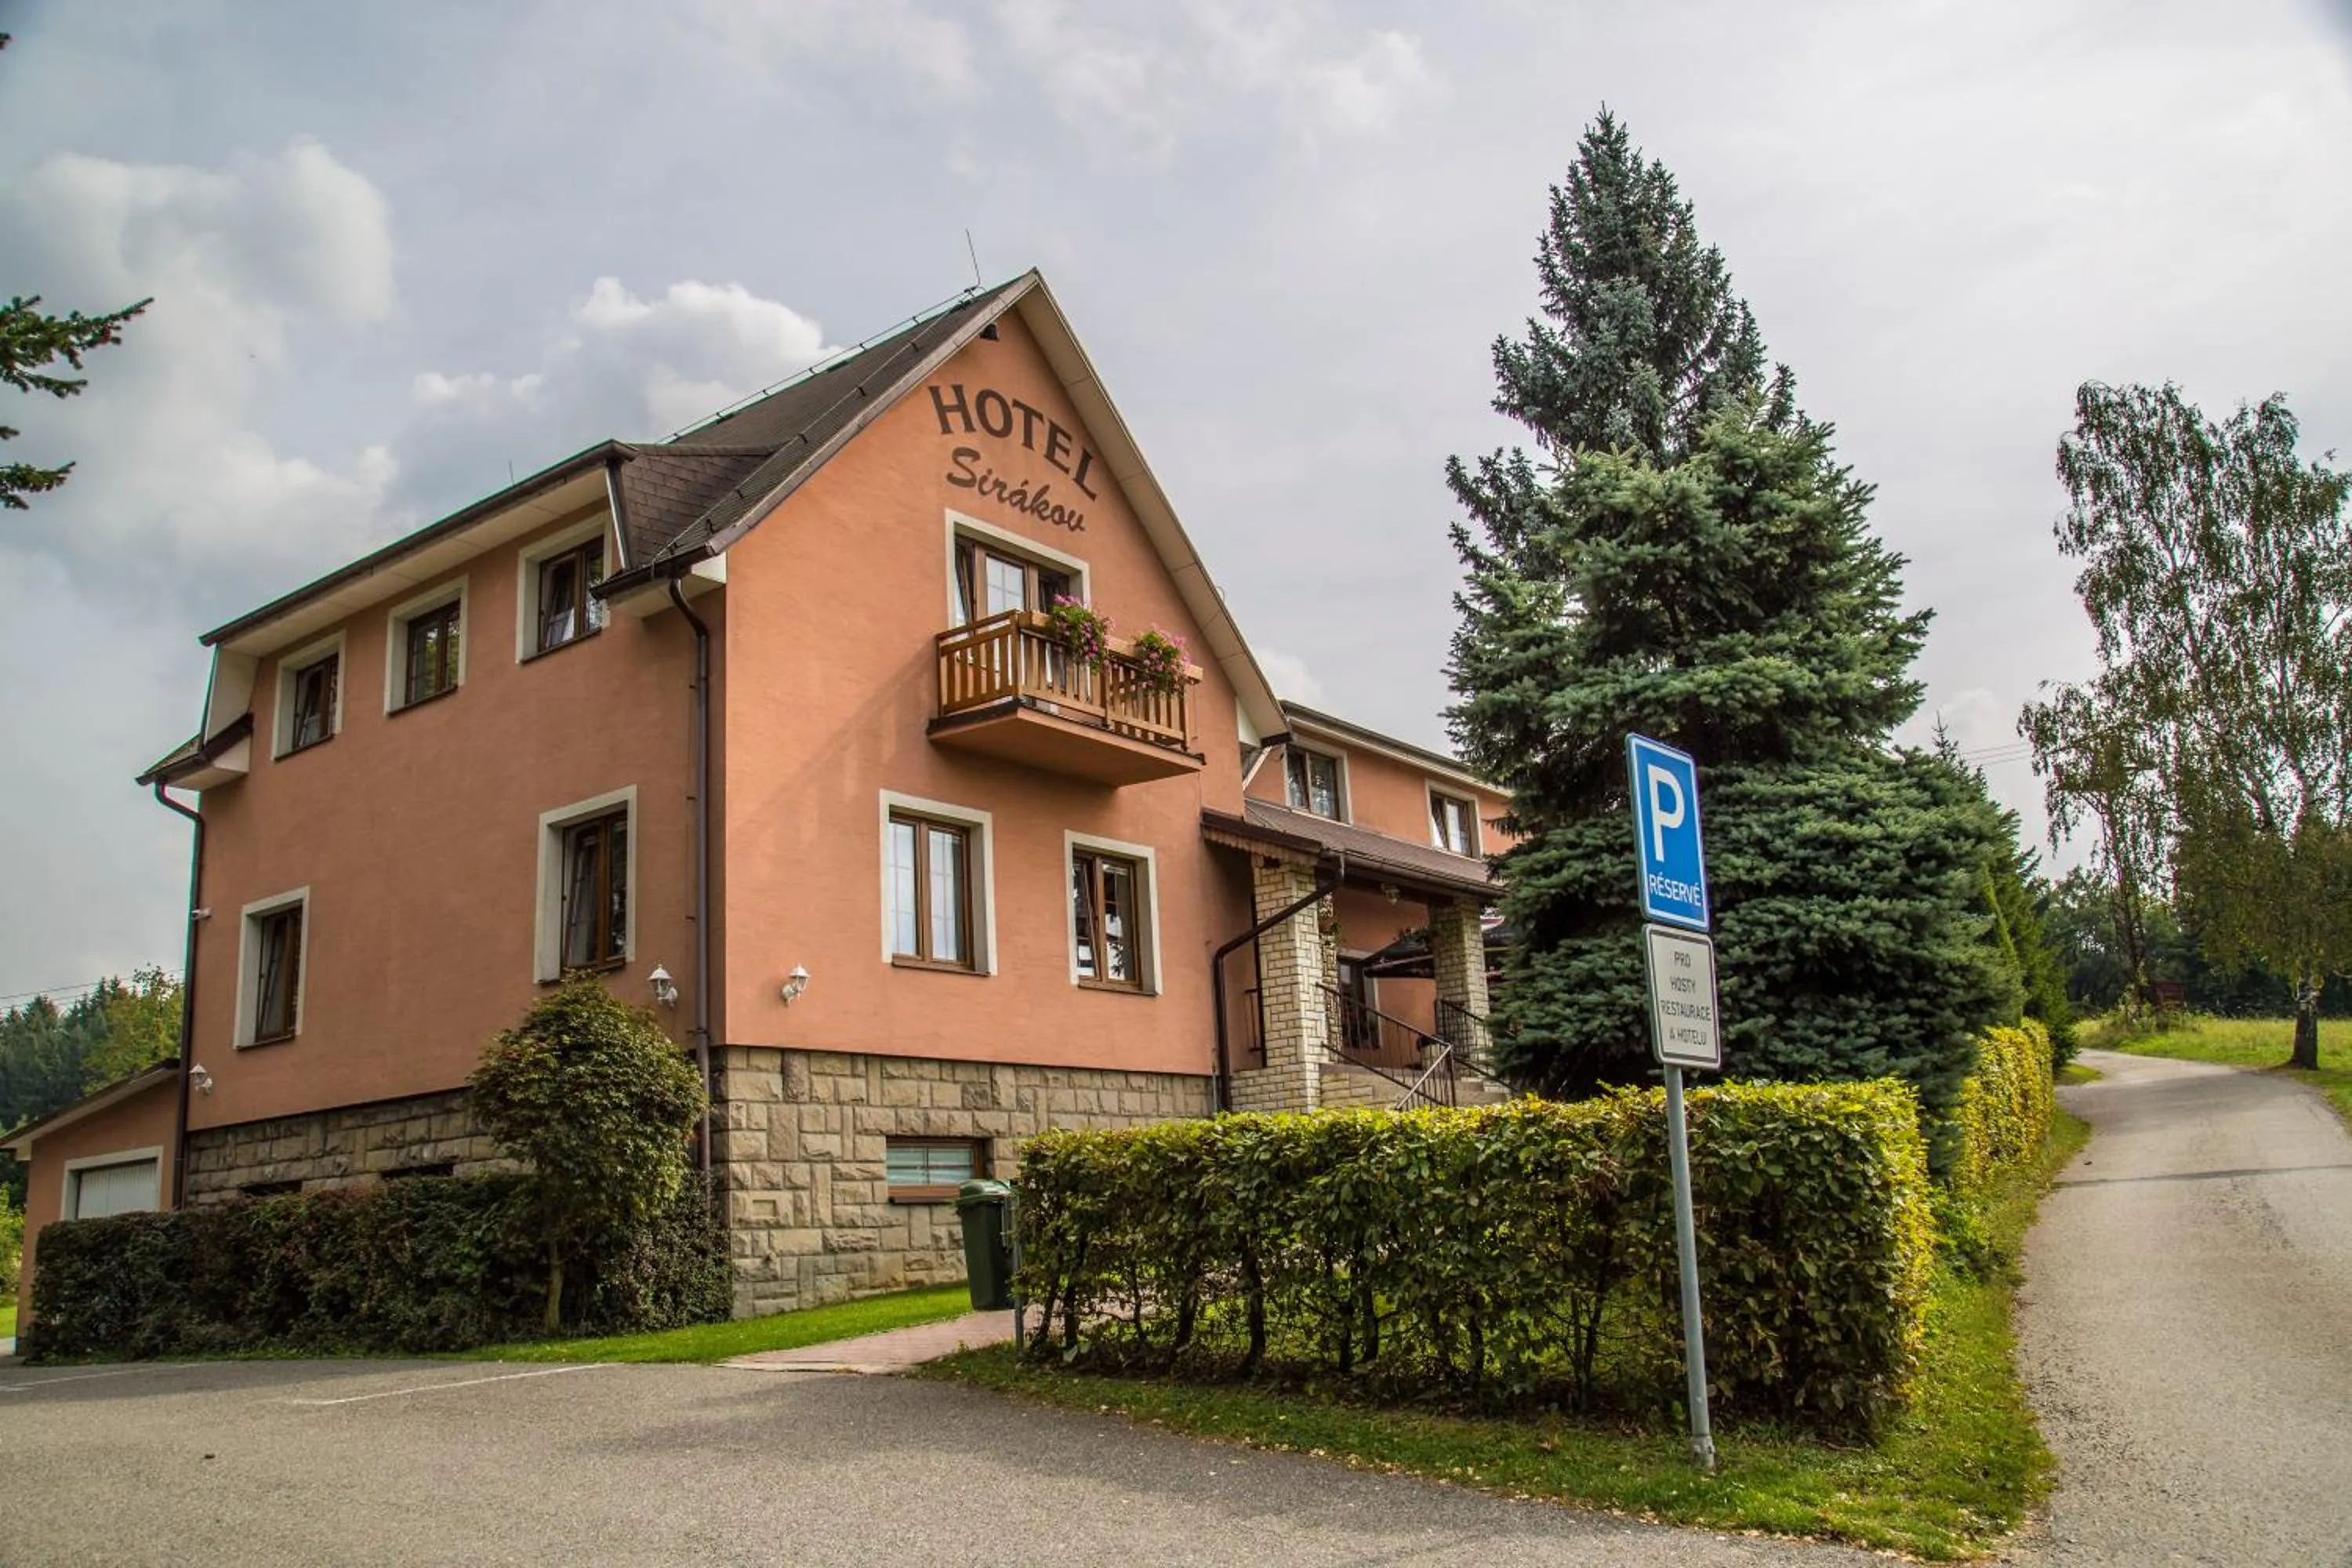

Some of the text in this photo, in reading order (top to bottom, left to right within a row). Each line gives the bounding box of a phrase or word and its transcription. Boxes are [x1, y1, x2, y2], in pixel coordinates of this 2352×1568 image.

[928, 384, 1097, 502] HOTEL
[946, 446, 1086, 532] Sirákov
[1648, 764, 1685, 862] P
[1649, 872, 1701, 906] RÉSERVÉ
[1674, 950, 1691, 968] PRO
[1670, 975, 1696, 993] HOSTY
[1661, 1000, 1711, 1022] RESTAURACE
[1678, 1028, 1707, 1046] HOTELU
